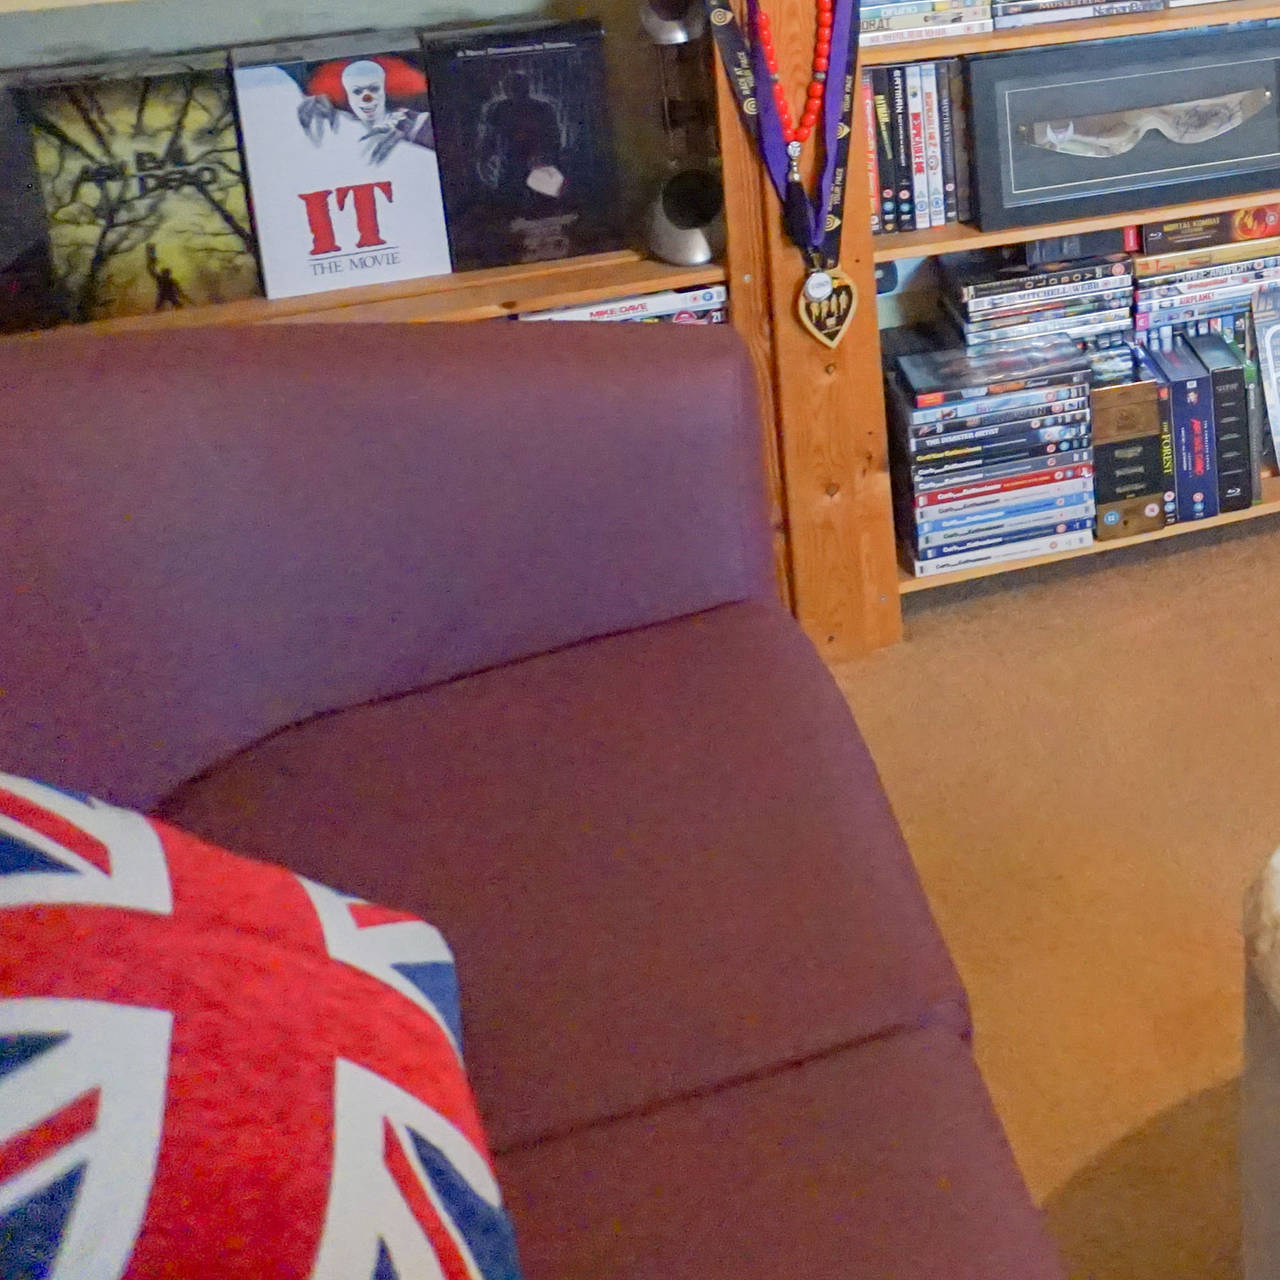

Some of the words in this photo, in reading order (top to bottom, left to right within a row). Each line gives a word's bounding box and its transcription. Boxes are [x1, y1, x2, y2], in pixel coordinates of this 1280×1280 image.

[911, 111, 923, 161] DESPICABLE
[298, 180, 394, 255] IT
[309, 261, 344, 276] THE
[349, 251, 401, 271] MOVIE
[1018, 286, 1068, 301] MITCHELL
[1179, 292, 1215, 305] AIRPLANE!
[618, 302, 648, 314] DAVE
[975, 427, 999, 439] ARTIST
[1161, 433, 1173, 475] FOREST
